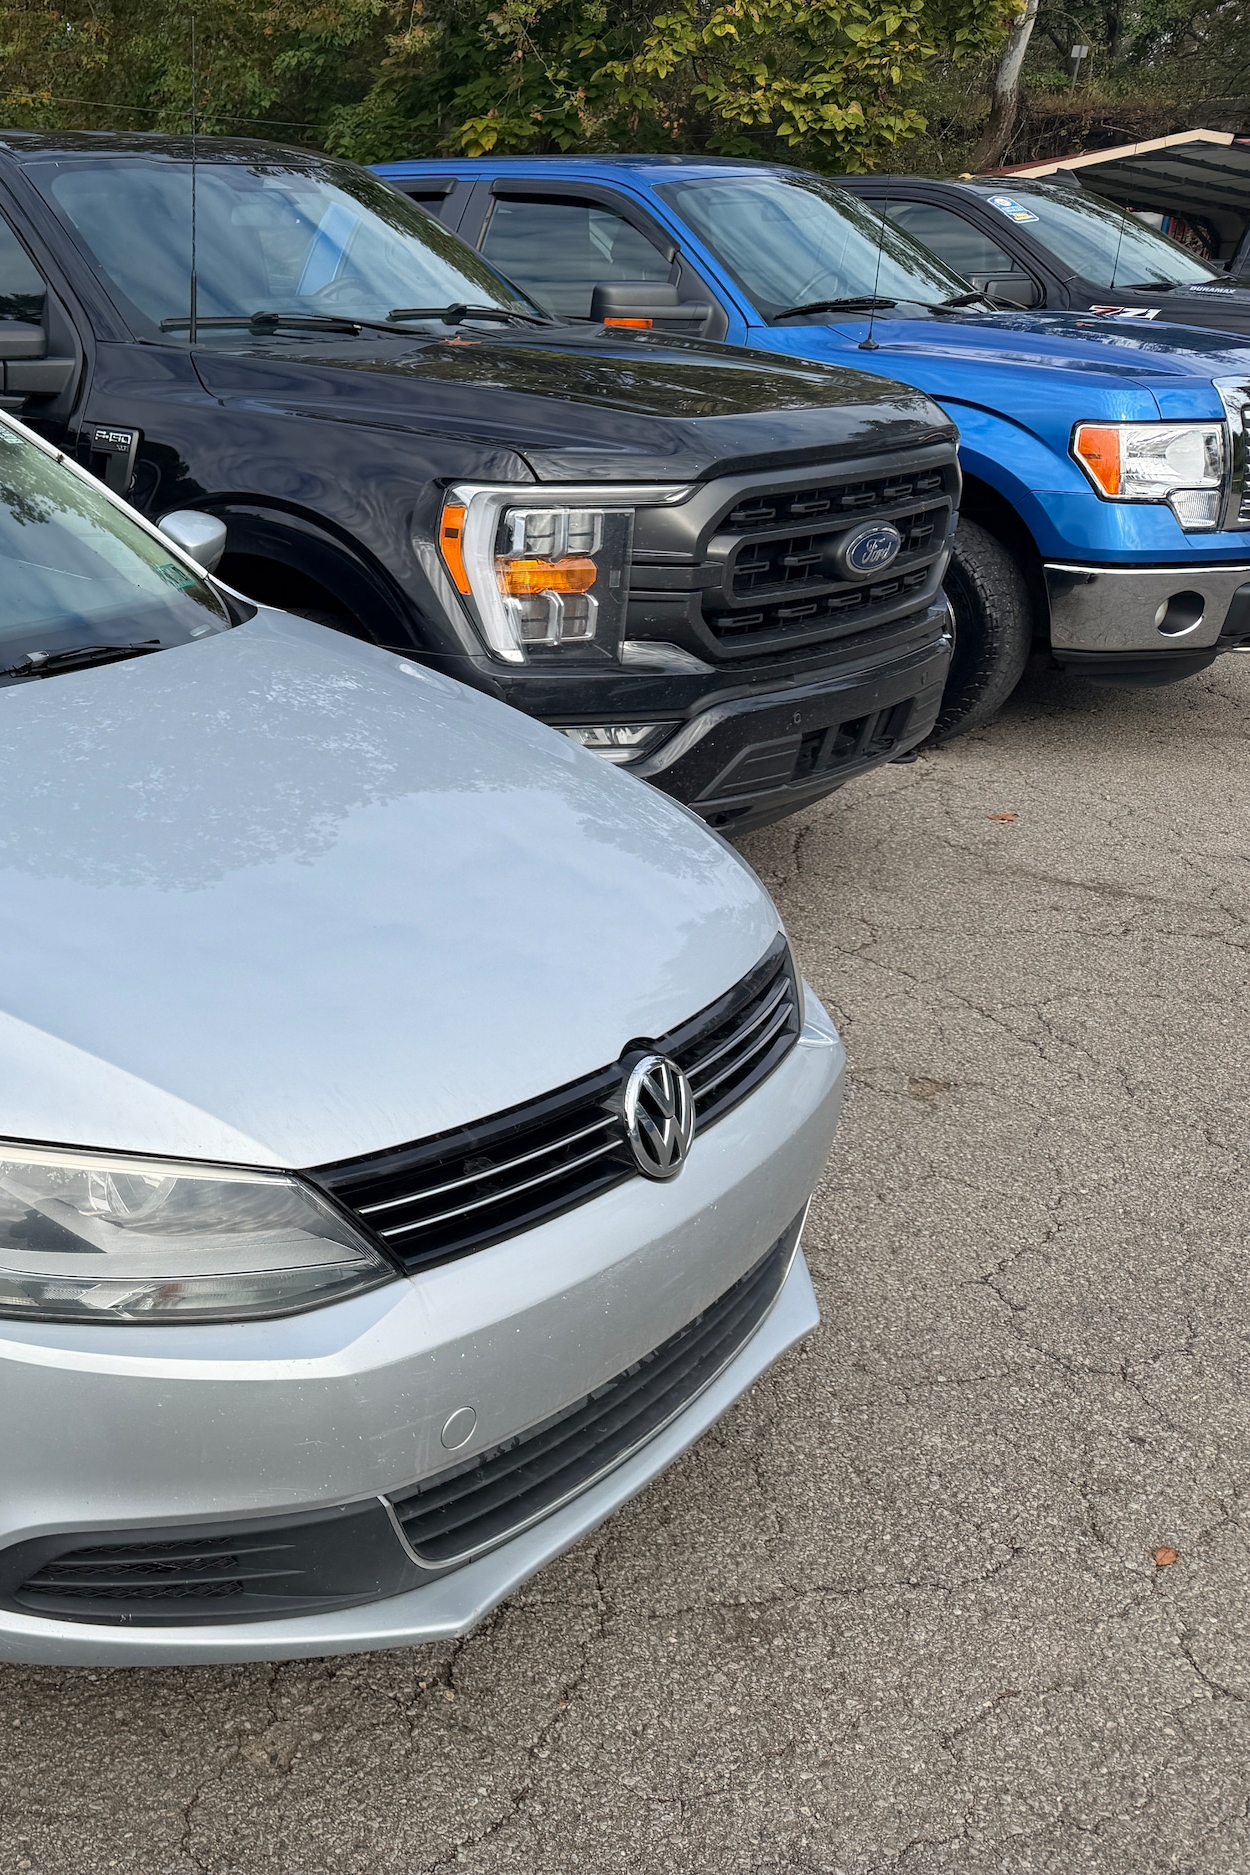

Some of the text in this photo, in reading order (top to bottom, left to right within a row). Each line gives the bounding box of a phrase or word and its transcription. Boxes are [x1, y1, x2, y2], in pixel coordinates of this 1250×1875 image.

[1190, 286, 1236, 295] DURAMAX
[95, 430, 132, 445] F-150
[861, 537, 892, 564] Ford
[627, 1058, 694, 1177] VW
